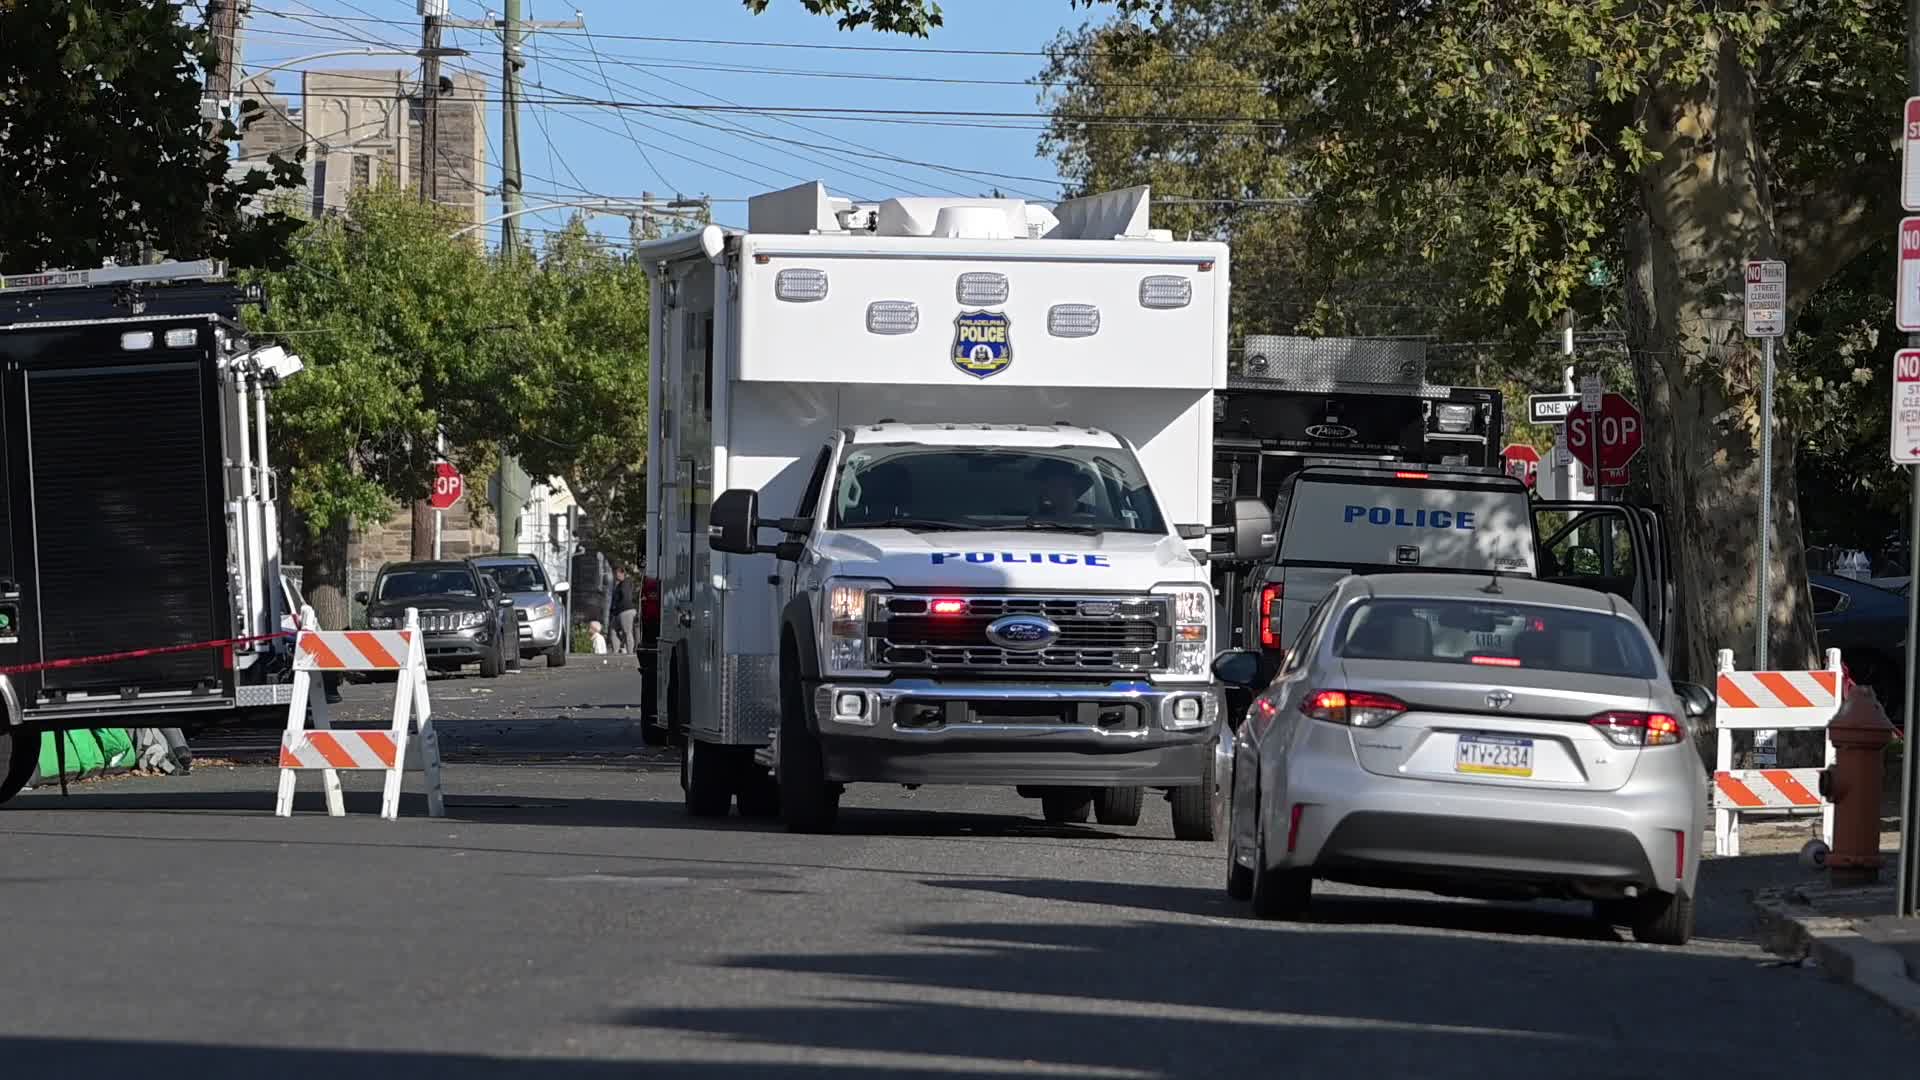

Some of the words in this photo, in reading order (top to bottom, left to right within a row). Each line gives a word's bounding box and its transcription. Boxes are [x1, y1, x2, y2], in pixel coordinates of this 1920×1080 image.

[1749, 266, 1760, 281] NO
[1753, 284, 1777, 292] STREET
[1749, 301, 1781, 310] WEDNESDAY
[959, 326, 1006, 342] POLICE
[1898, 355, 1919, 378] NO
[1538, 402, 1561, 415] ONE
[434, 476, 460, 495] OP
[1344, 504, 1476, 530] POLICE
[930, 551, 1111, 567] POLICE
